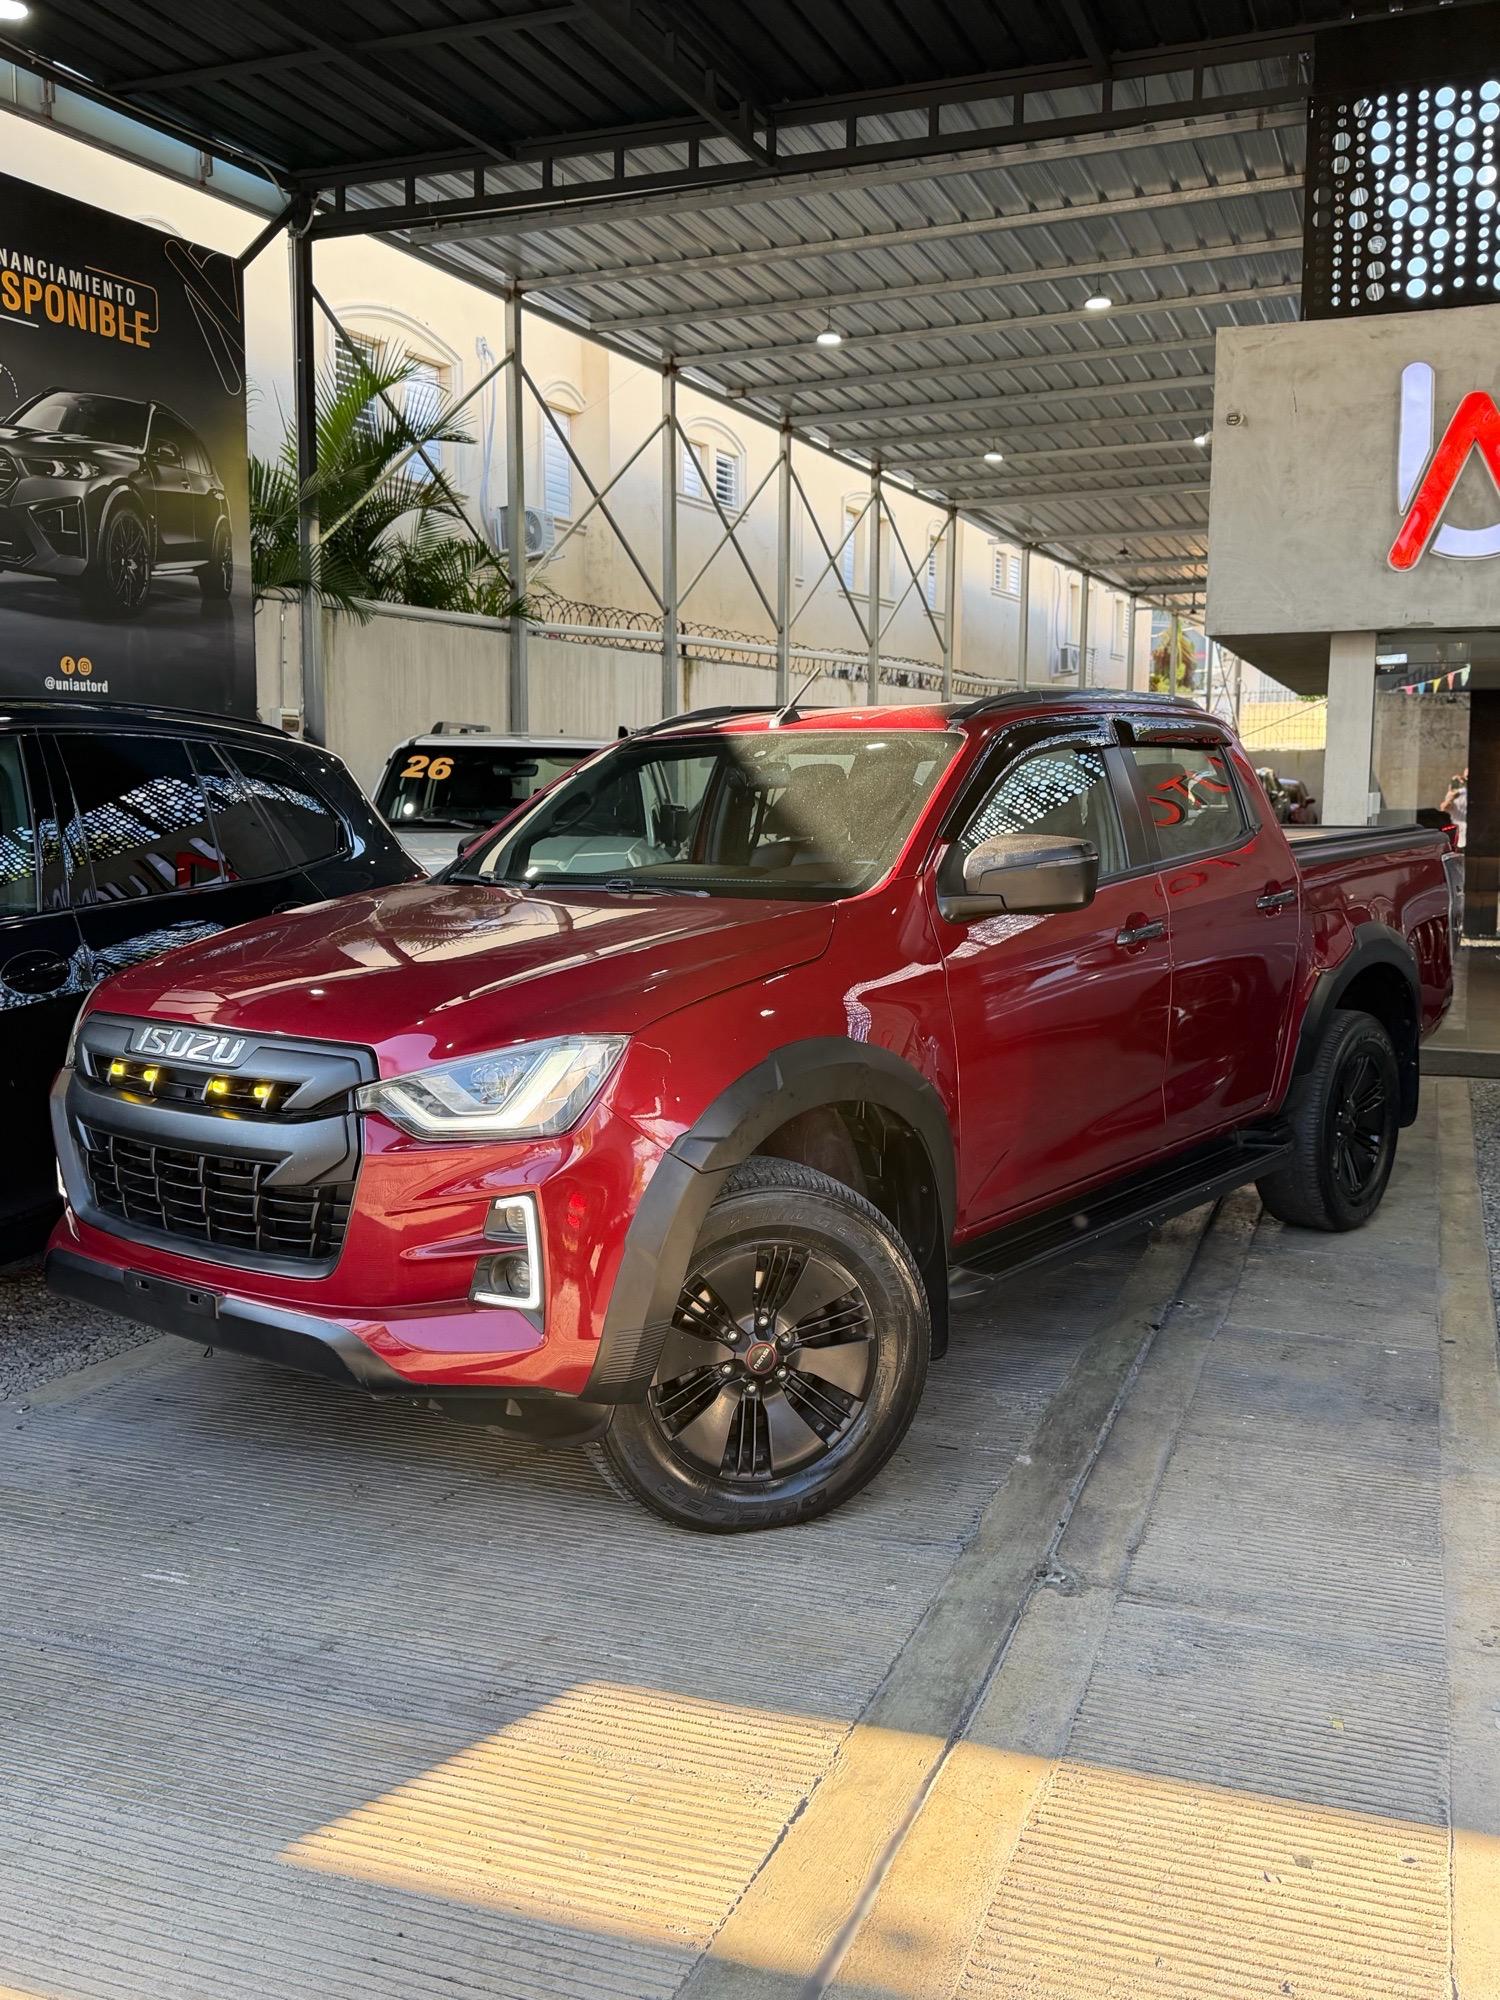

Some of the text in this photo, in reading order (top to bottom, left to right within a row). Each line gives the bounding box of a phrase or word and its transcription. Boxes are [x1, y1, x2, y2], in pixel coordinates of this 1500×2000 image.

[1, 270, 151, 349] SPONIBLE
[44, 676, 109, 693] @uniautord
[400, 755, 454, 780] 26
[135, 1025, 246, 1064] ISUZU
